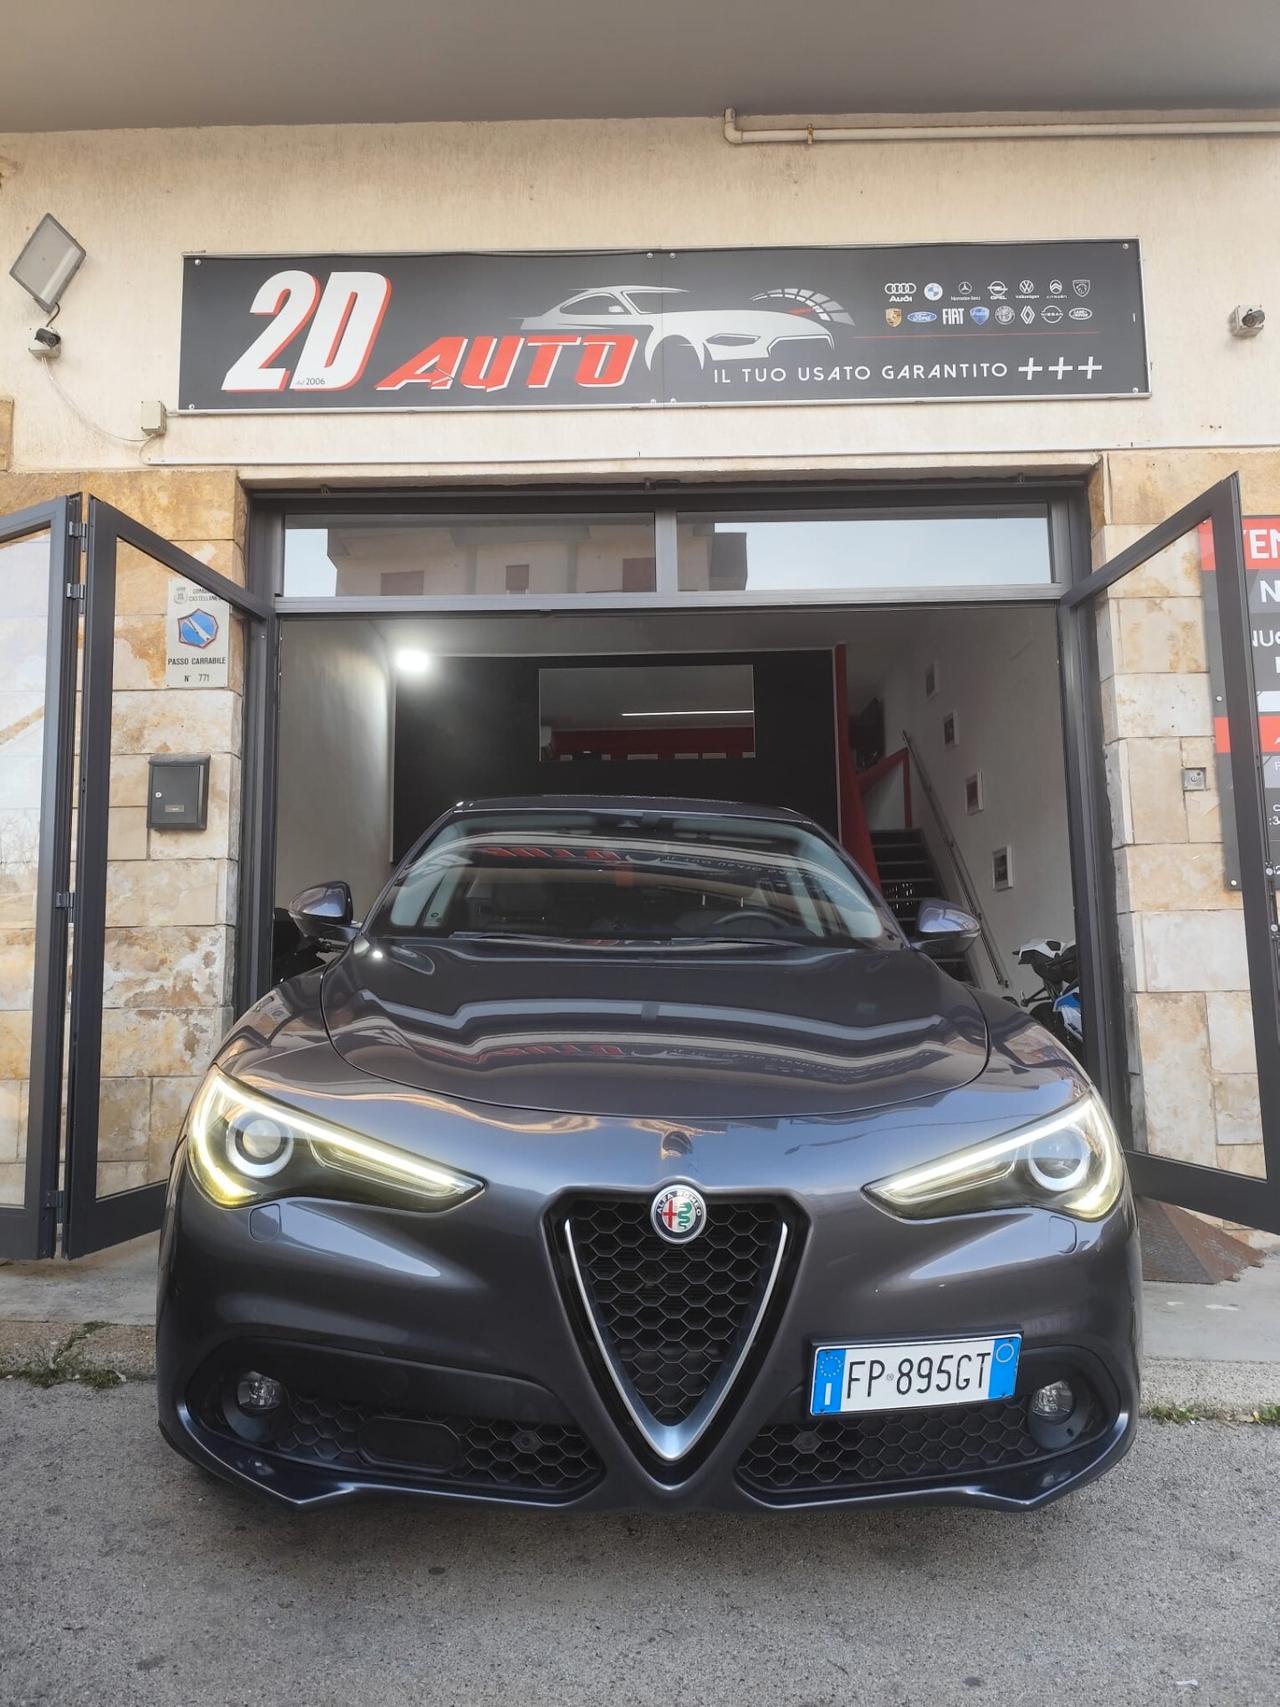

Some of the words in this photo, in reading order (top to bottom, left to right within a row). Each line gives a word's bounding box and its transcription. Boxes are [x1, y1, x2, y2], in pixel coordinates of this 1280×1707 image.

[942, 308, 965, 325] FIAT
[374, 335, 639, 392] AUTO
[713, 369, 731, 384] IL
[742, 367, 787, 383] TUO
[798, 365, 871, 381] USATO
[881, 362, 1008, 380] GARANTITO
[305, 377, 326, 386] 2006
[167, 657, 189, 666] PASSO
[191, 656, 227, 665] CARRABILE
[846, 1360, 886, 1399] FP
[896, 1352, 991, 1395] 895GT
